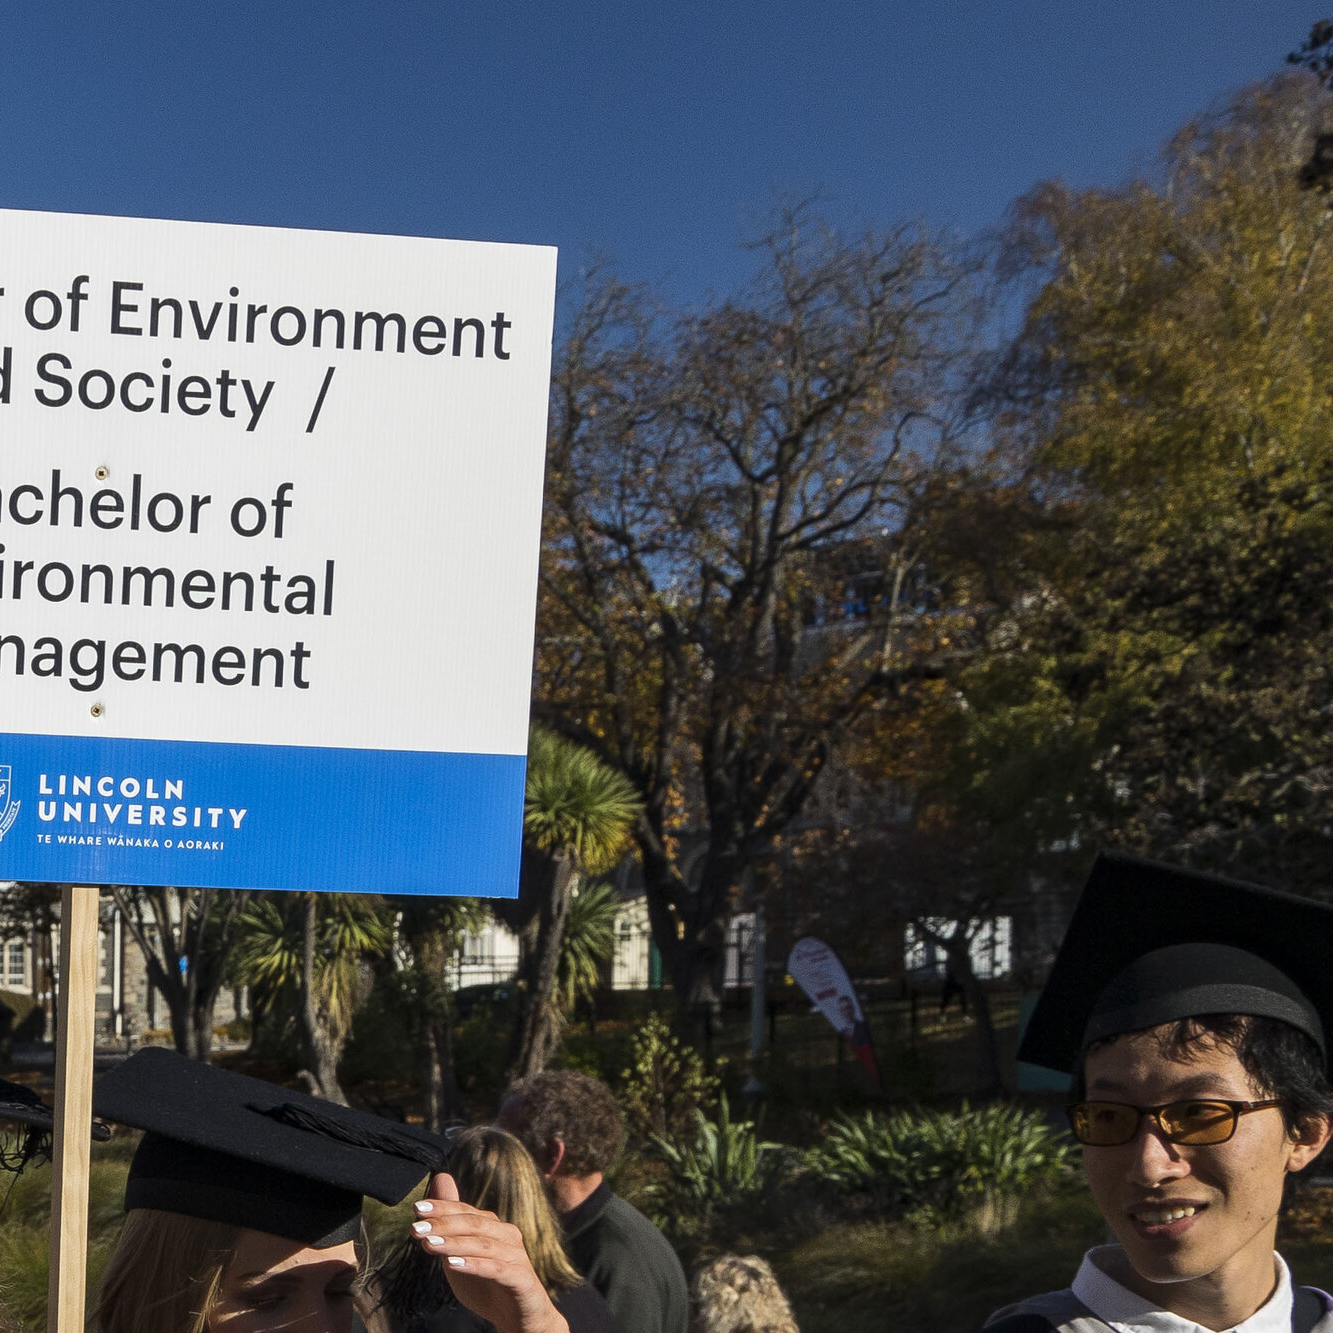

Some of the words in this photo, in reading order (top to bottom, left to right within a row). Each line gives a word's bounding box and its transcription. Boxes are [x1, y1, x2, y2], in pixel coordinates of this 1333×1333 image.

[24, 275, 90, 332] of
[110, 280, 512, 361] Environment
[34, 352, 276, 432] Society
[305, 366, 336, 434] /
[229, 482, 294, 539] of
[39, 773, 184, 801] LINCOLN
[38, 800, 247, 829] UNIVERSITY
[36, 833, 52, 844] TE
[57, 834, 102, 846] WHARE
[163, 839, 173, 849] O
[177, 839, 224, 851] AORAKI
